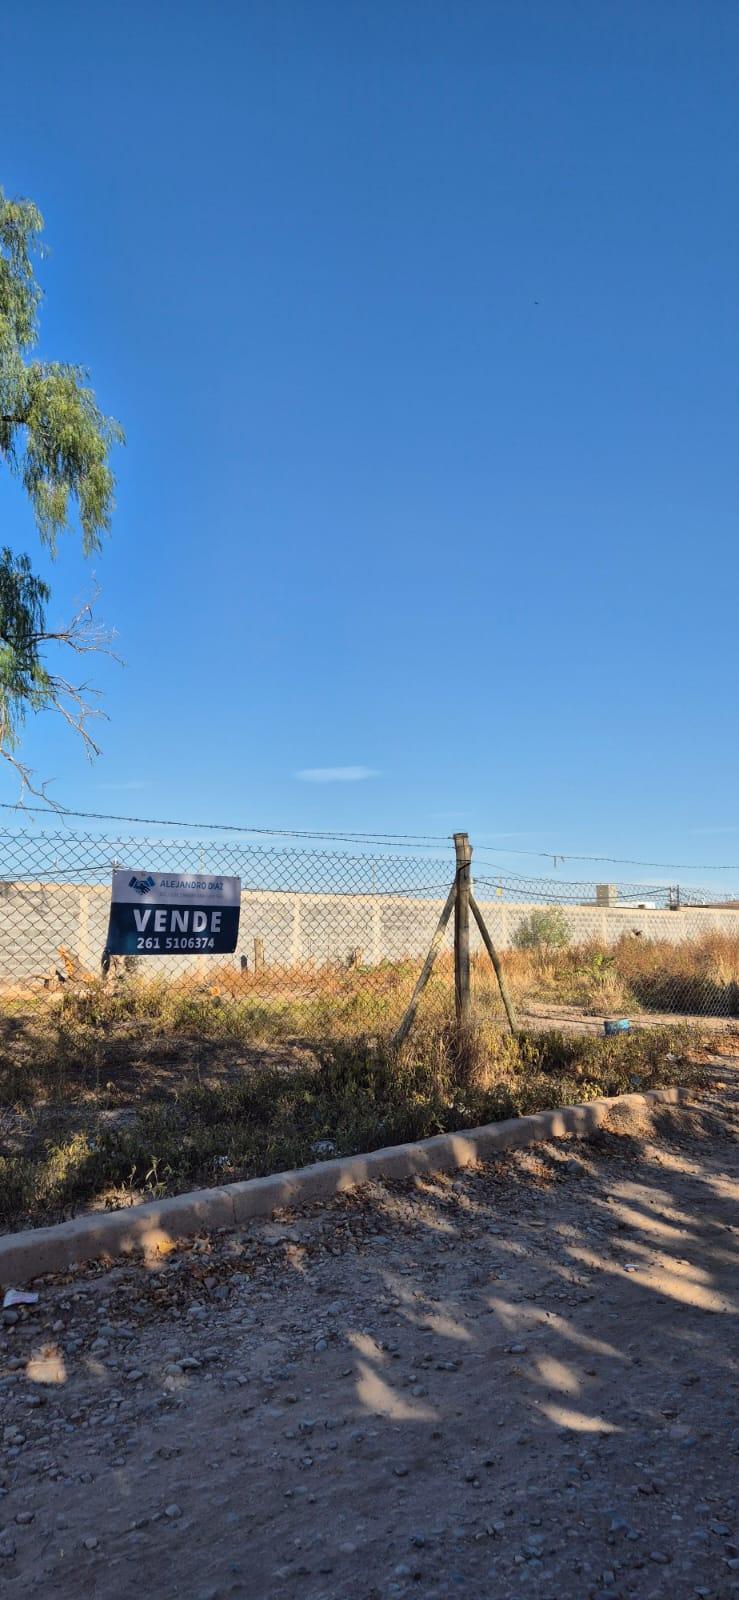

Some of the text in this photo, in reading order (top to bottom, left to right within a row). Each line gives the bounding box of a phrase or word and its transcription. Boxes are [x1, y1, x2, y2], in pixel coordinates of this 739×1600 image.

[160, 880, 206, 890] ALEJANDRO
[133, 909, 222, 932] VENDE
[137, 938, 215, 949] 261 5106374
